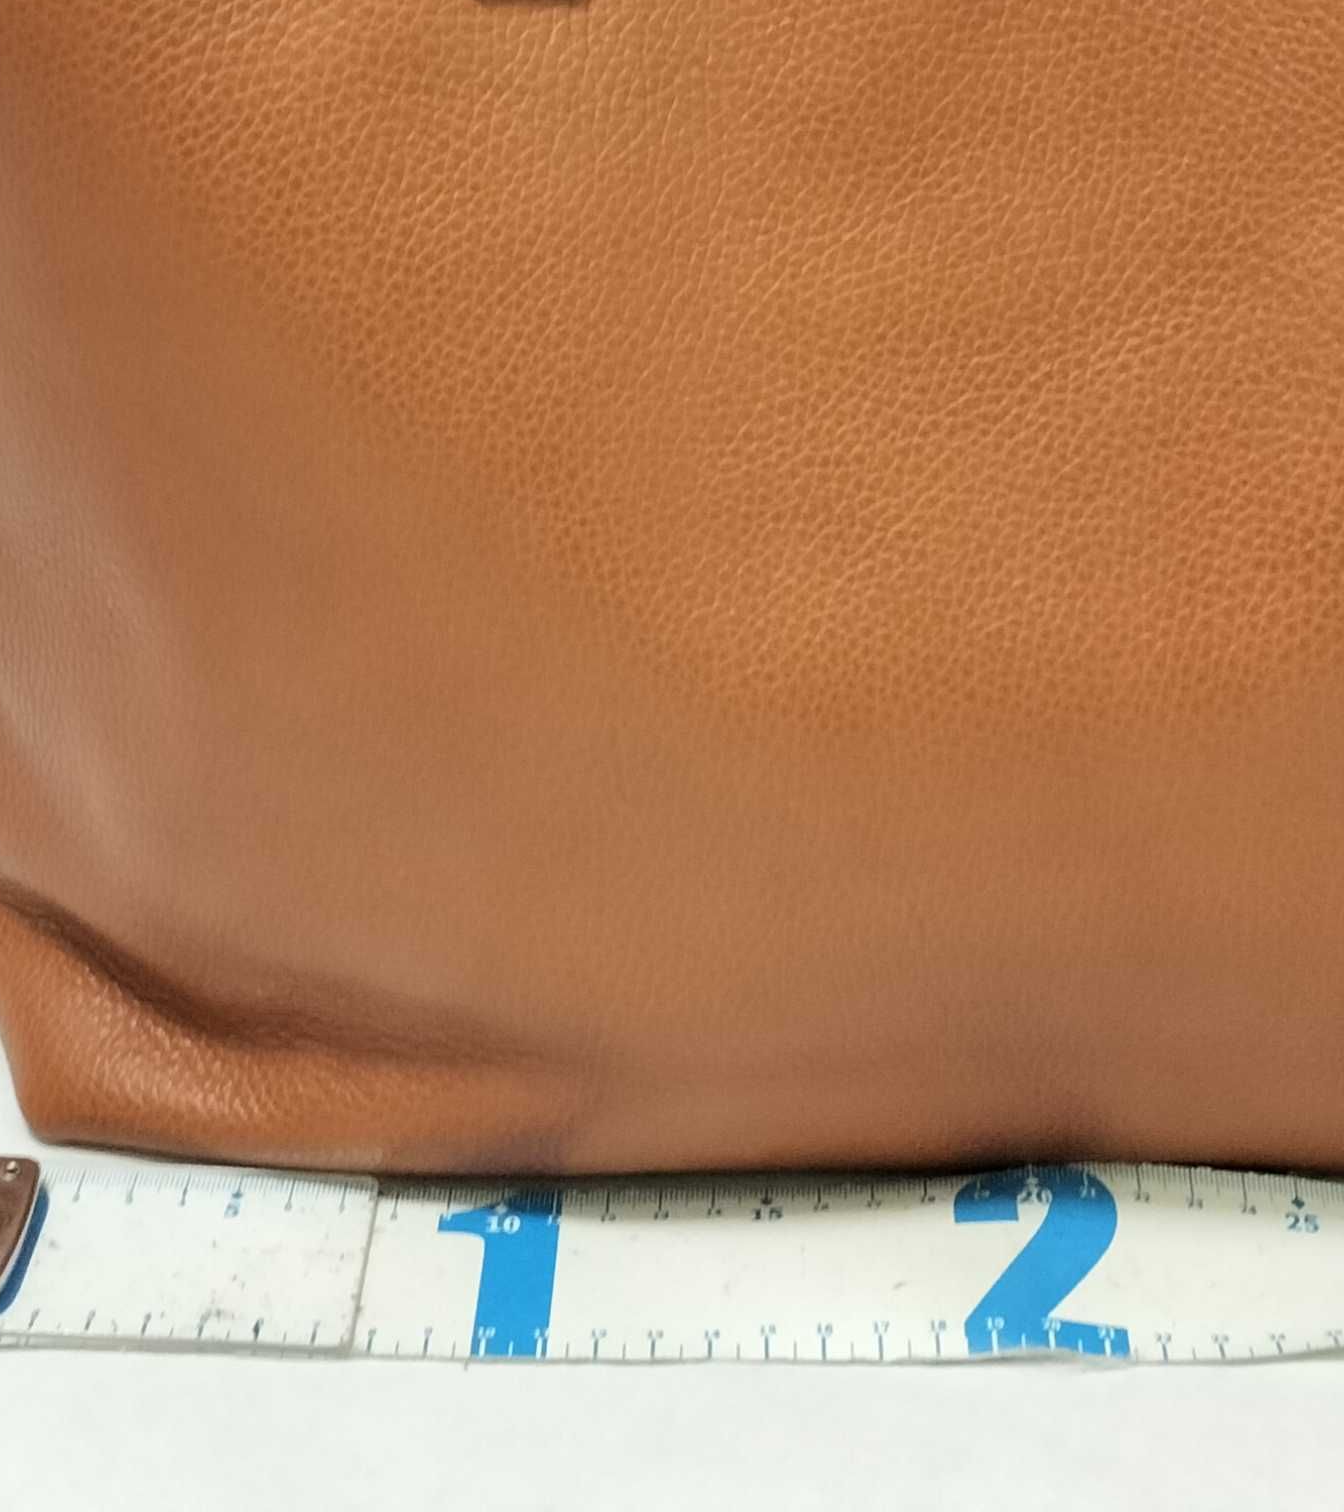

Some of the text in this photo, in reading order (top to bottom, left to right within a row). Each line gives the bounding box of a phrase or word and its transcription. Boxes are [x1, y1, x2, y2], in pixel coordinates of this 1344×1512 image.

[437, 1186, 561, 1357] 1
[953, 1164, 1130, 1356] 2
[485, 1214, 521, 1235] 10
[751, 1206, 784, 1222] 15
[1017, 1187, 1053, 1205] 20
[1284, 1211, 1320, 1234] 25
